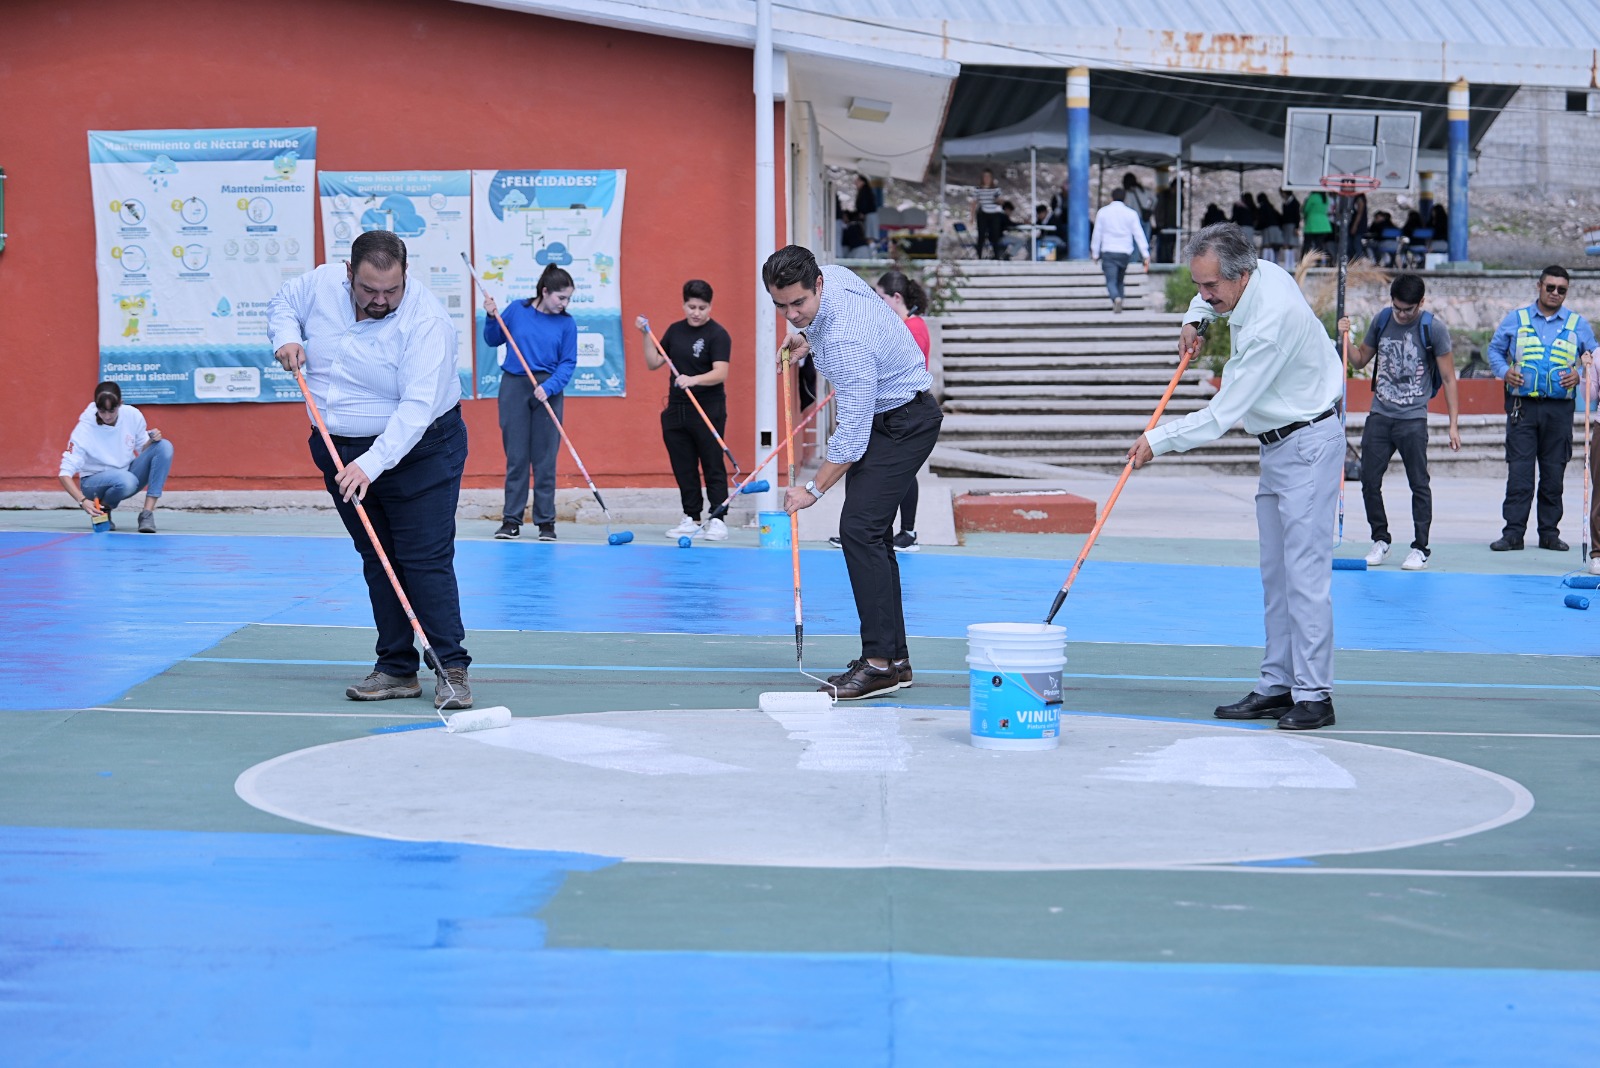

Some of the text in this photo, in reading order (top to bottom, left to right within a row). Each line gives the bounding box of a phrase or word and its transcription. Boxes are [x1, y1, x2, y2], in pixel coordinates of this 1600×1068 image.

[104, 138, 299, 152] Mantenimiento de Néctar de Nube
[501, 175, 598, 188] ¡FELICIDADES!
[220, 184, 306, 194] Mantenimiento:
[358, 183, 393, 192] purifica
[406, 183, 432, 193] agua?
[104, 361, 162, 373] ¡Gracias por
[104, 371, 189, 381] cuidar tu sistema!
